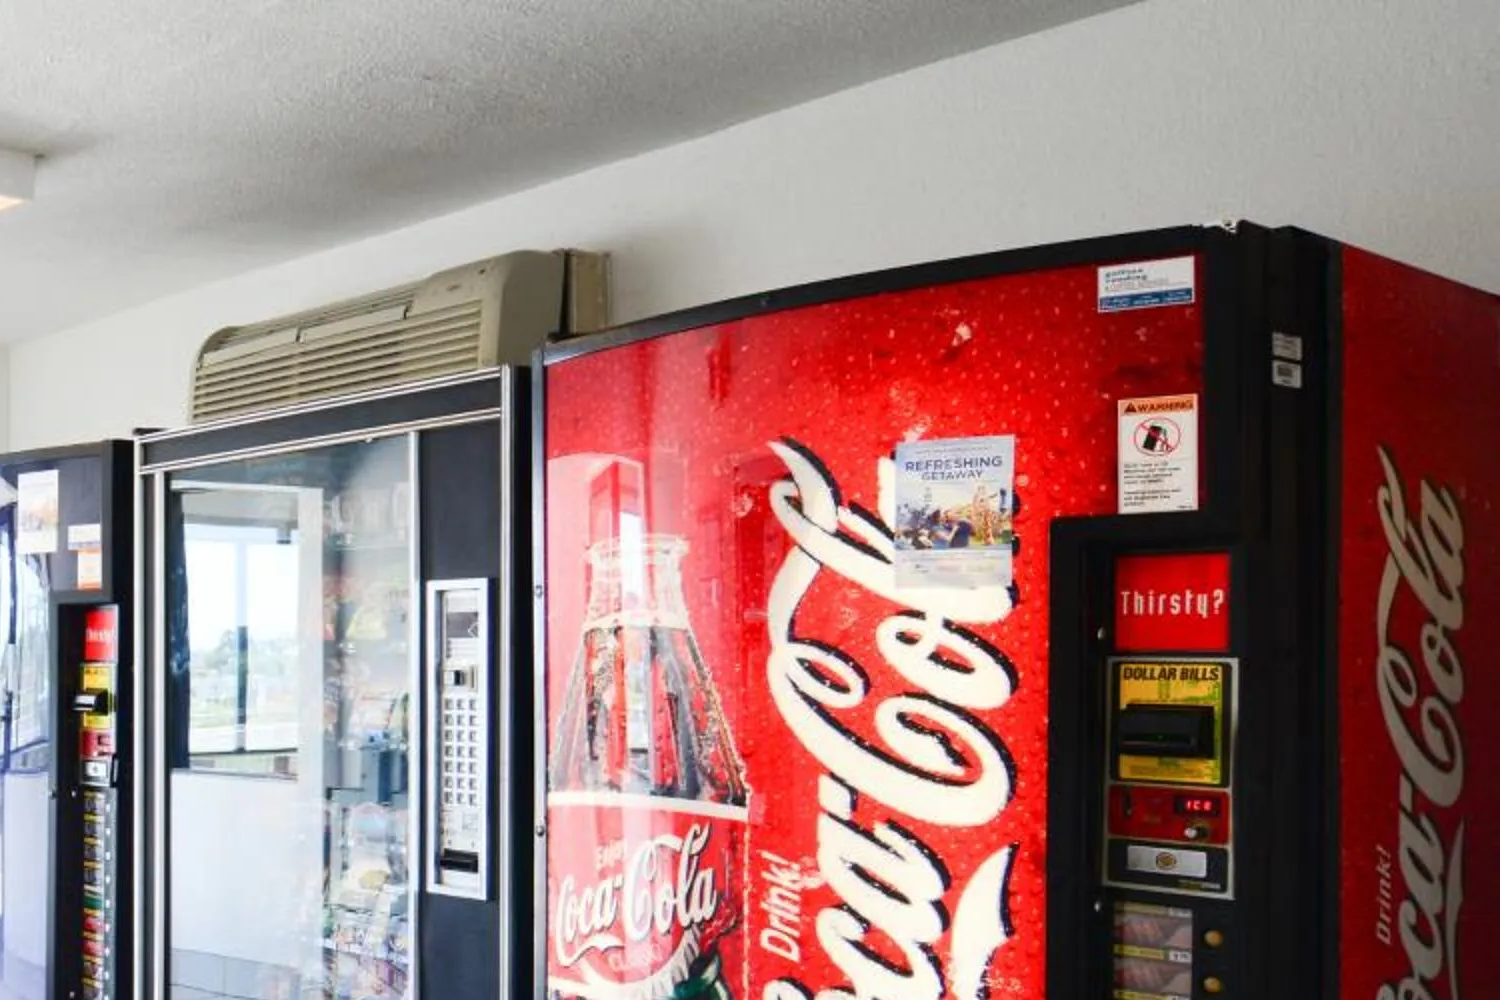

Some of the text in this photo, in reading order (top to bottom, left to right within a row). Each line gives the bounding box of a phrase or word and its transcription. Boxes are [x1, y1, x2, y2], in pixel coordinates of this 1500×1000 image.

[904, 455, 1003, 473] REFRESHING
[921, 470, 984, 481] GETAWAY
[1120, 588, 1225, 619] Thirsty?
[1123, 666, 1219, 681] DOLLAR BILLS
[555, 821, 719, 968] Coca-Cola
[759, 850, 802, 963] Drink!
[1375, 843, 1392, 946] Drink!
